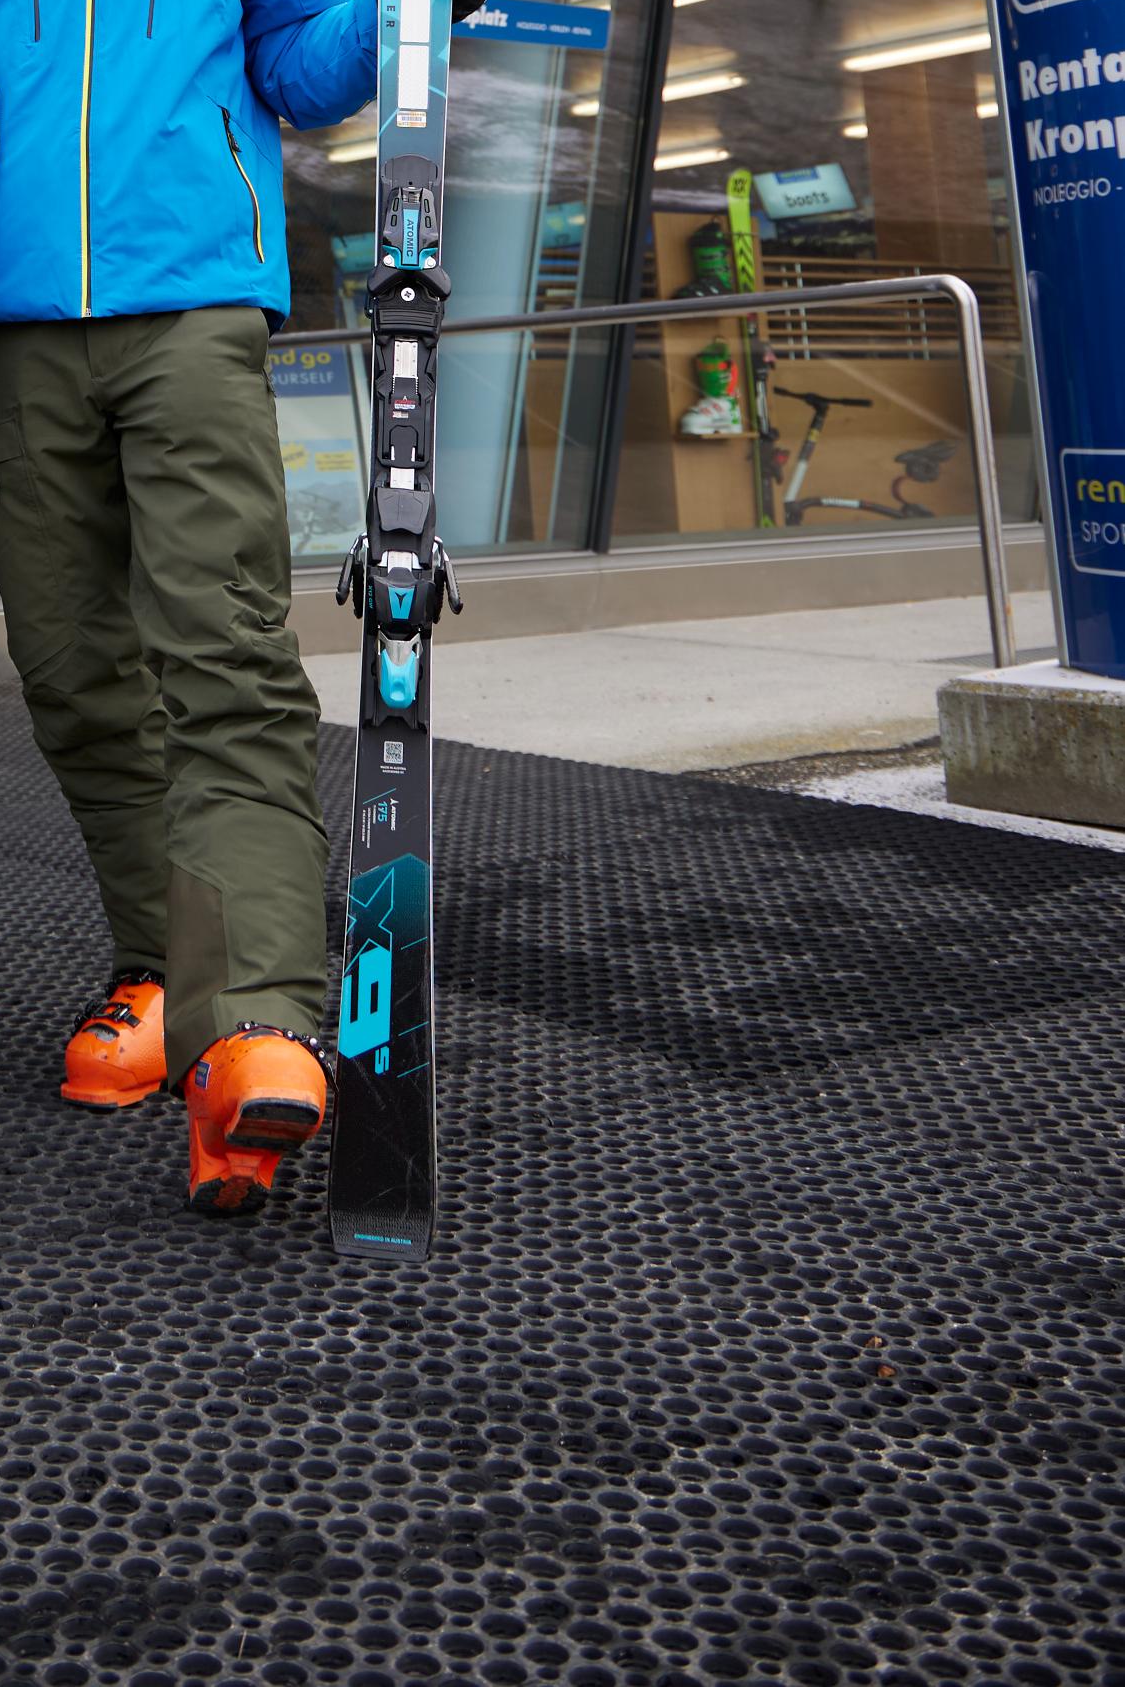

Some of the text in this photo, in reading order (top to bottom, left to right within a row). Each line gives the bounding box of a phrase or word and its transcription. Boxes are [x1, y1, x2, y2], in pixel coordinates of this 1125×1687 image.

[784, 192, 830, 208] boots
[1033, 177, 1111, 206] NOLEGGIO
[406, 219, 415, 257] ATOMIC
[300, 353, 331, 369] go
[378, 801, 387, 822] 175
